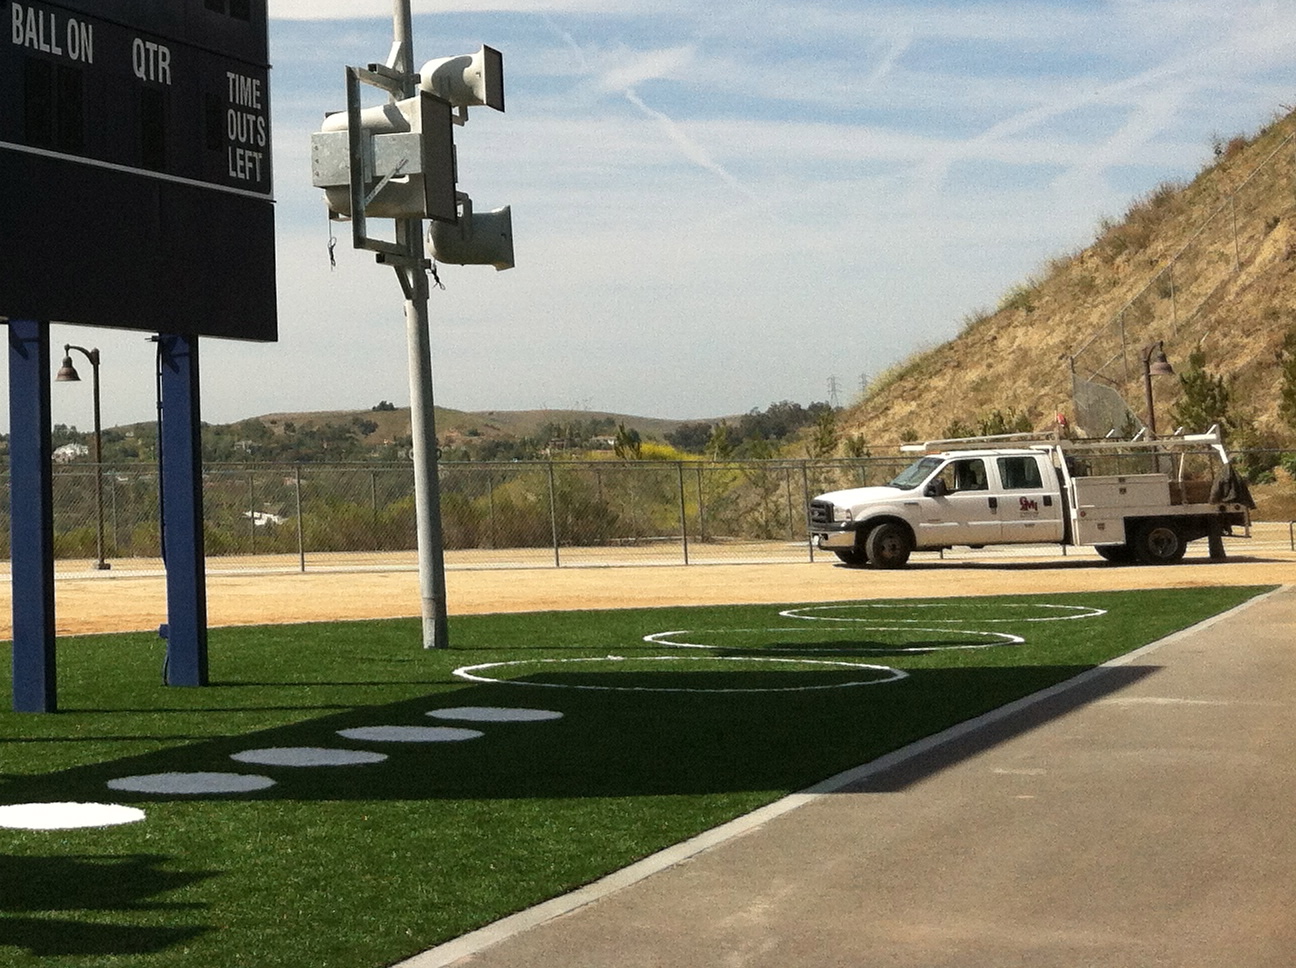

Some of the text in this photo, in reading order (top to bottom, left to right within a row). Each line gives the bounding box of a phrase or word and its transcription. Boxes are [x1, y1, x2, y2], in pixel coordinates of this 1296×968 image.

[11, 2, 94, 64] BALL ON
[132, 37, 173, 85] QTR
[226, 71, 262, 110] TIME
[226, 108, 266, 148] OUTS
[227, 146, 263, 183] LEFT
